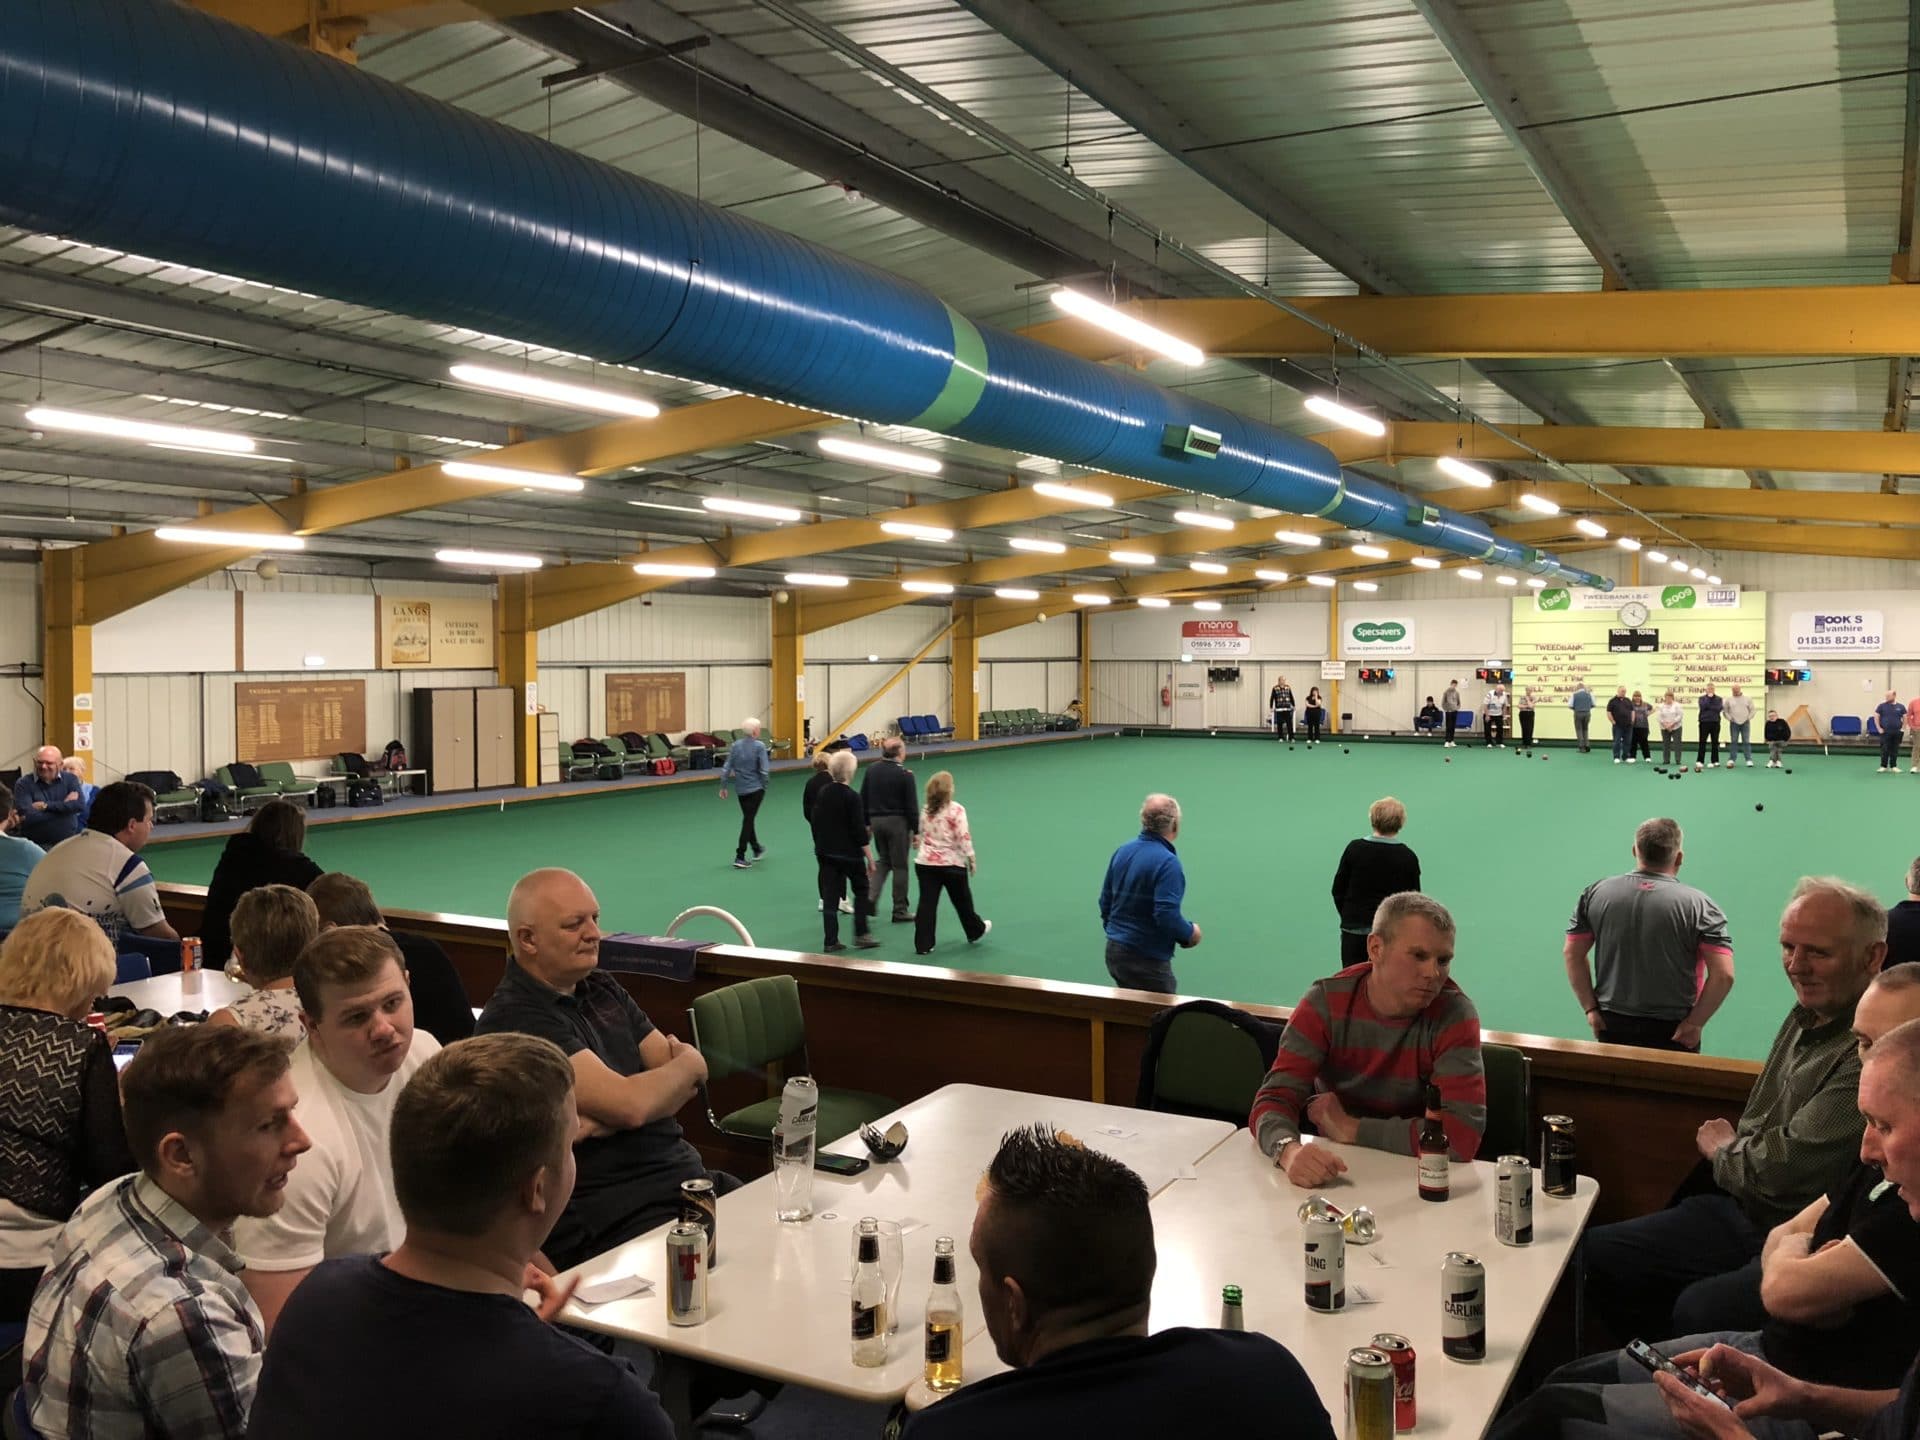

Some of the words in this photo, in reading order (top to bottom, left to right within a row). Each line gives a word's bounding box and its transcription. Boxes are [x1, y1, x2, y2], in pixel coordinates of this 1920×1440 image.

[1665, 587, 1693, 607] 2009
[393, 607, 428, 616] LANGS
[1356, 627, 1402, 638] Specsavers
[1797, 636, 1831, 645] 01835
[1835, 636, 1855, 645] 823
[1860, 636, 1880, 645] 483
[1722, 653, 1756, 661] MARCH
[679, 1253, 701, 1281] T
[1444, 1300, 1486, 1318] CARLING
